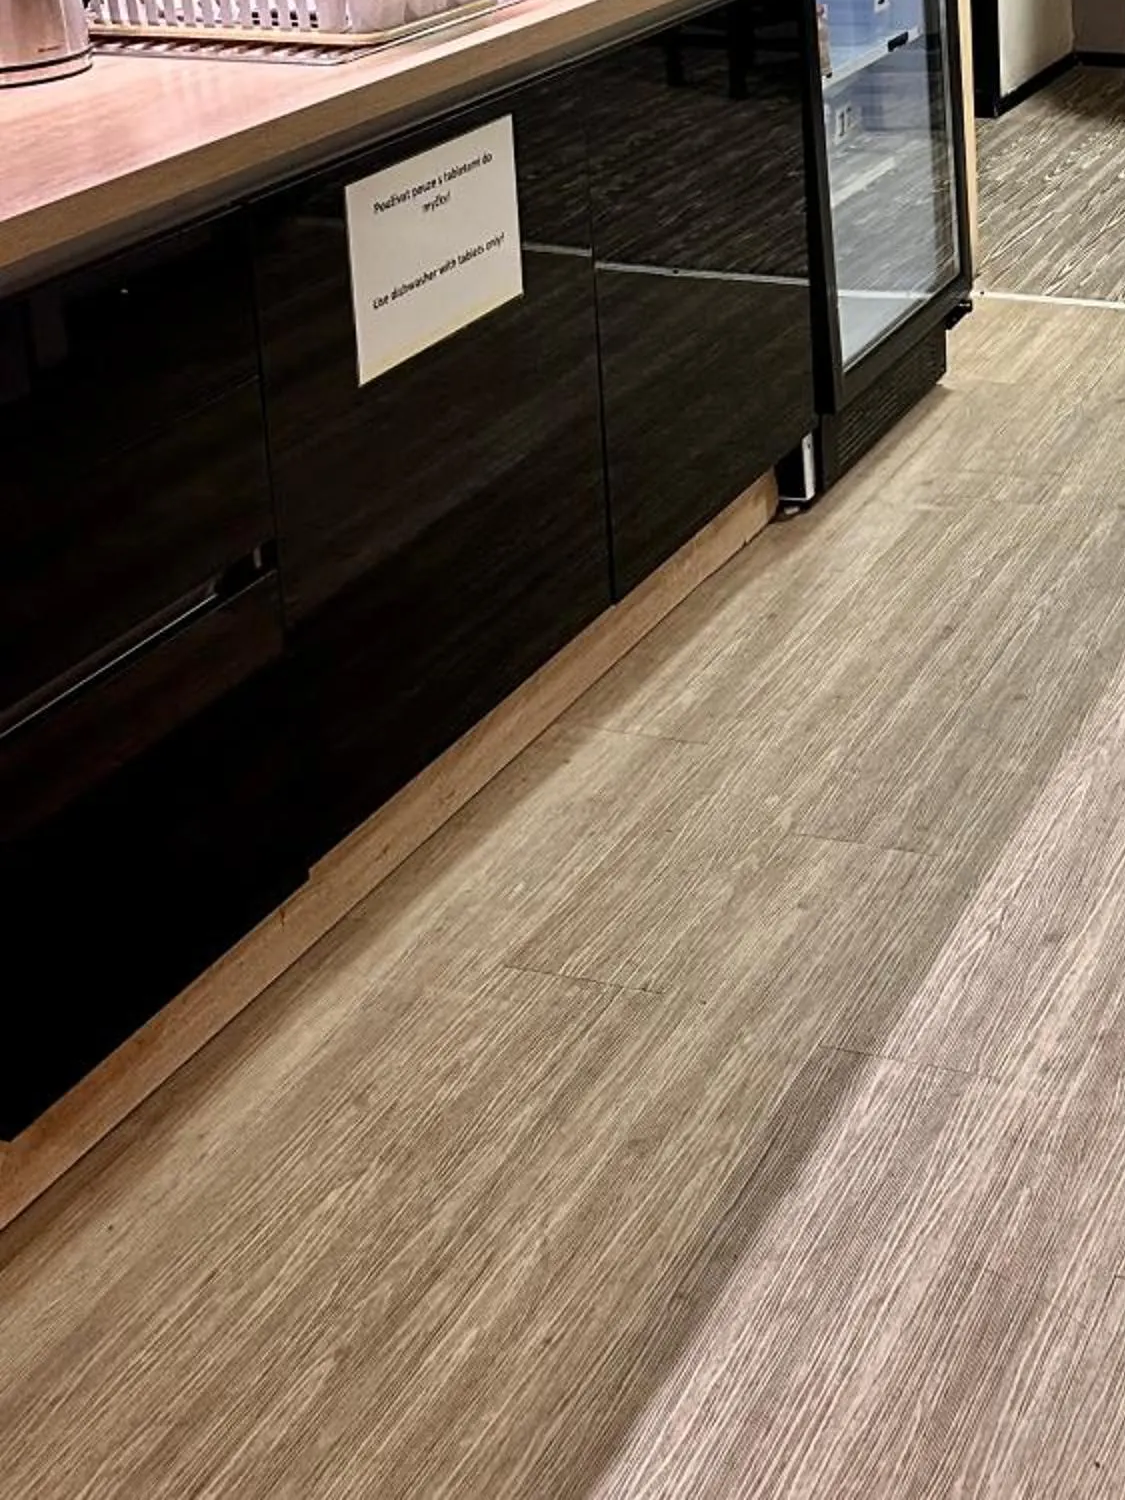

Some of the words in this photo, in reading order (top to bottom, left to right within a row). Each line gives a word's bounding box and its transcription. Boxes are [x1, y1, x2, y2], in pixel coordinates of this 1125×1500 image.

[481, 150, 493, 165] do
[372, 294, 389, 309] Use
[390, 268, 438, 301] dishwasher
[439, 258, 457, 275] with
[457, 245, 485, 265] tablets
